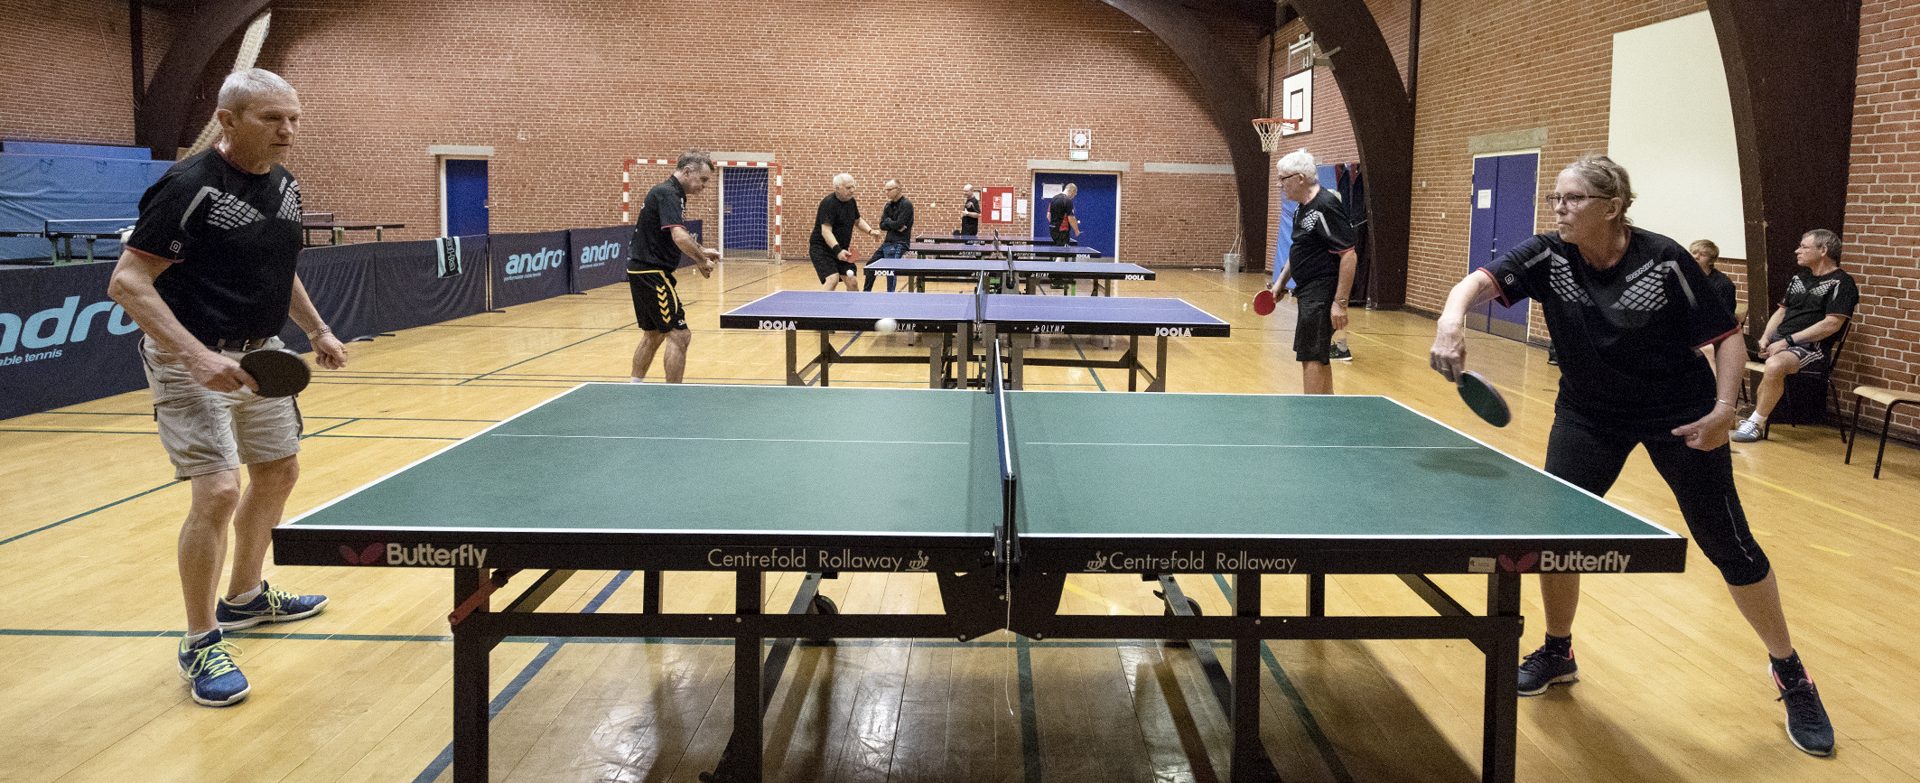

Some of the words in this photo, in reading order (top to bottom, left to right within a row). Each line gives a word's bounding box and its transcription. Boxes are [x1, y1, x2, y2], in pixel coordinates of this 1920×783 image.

[505, 247, 564, 275] andro
[580, 240, 620, 264] andro
[758, 320, 797, 331] JOOLA
[893, 323, 917, 331] LYMP
[1041, 324, 1065, 333] OLYMP
[1155, 327, 1193, 337] JOOLA
[25, 349, 63, 362] tennis
[386, 543, 487, 568] Butterfly
[707, 547, 806, 568] Centrefold
[818, 549, 903, 572] Rollaway
[1109, 550, 1205, 570] Centrefold
[1216, 551, 1297, 573] Rollaway
[1540, 550, 1631, 573] Butterfly
